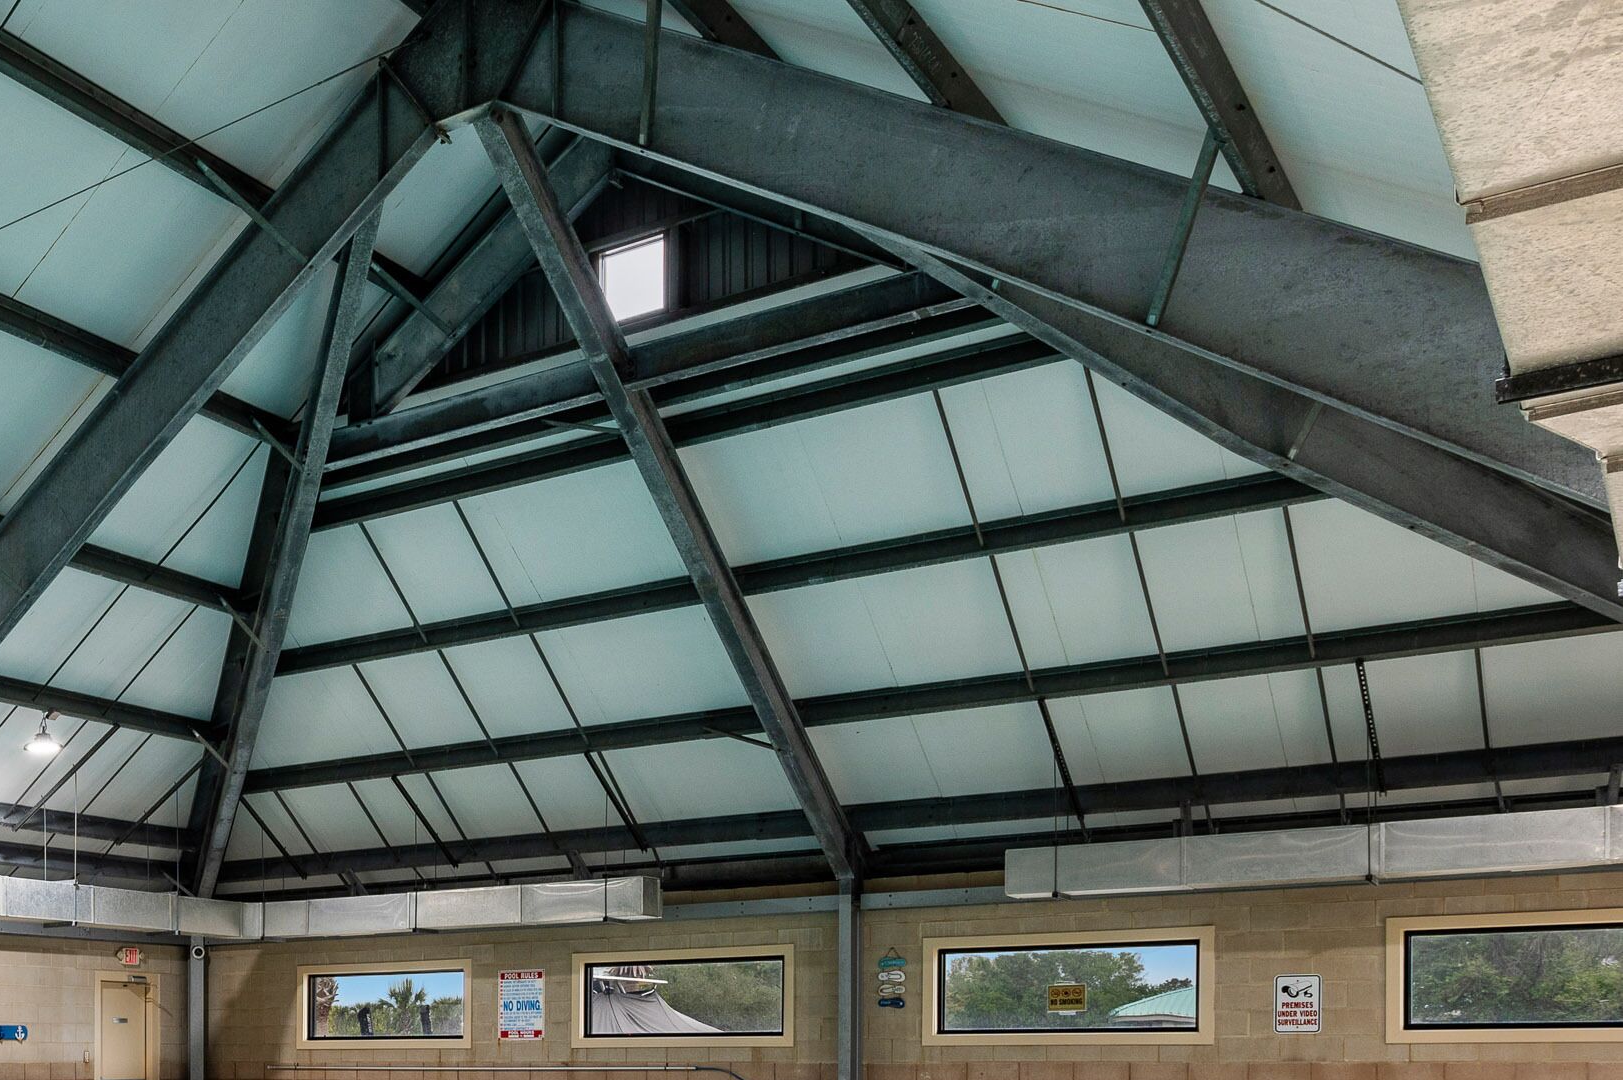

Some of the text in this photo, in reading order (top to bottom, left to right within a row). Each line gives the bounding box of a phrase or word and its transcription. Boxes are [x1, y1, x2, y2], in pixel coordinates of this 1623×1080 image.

[503, 1000, 513, 1012] NO
[1050, 998, 1058, 1006] NO
[1281, 1001, 1314, 1009] PREMISES
[1277, 1010, 1317, 1018] UNDER VIDEO
[1277, 1018, 1318, 1026] SURVEILLANCE
